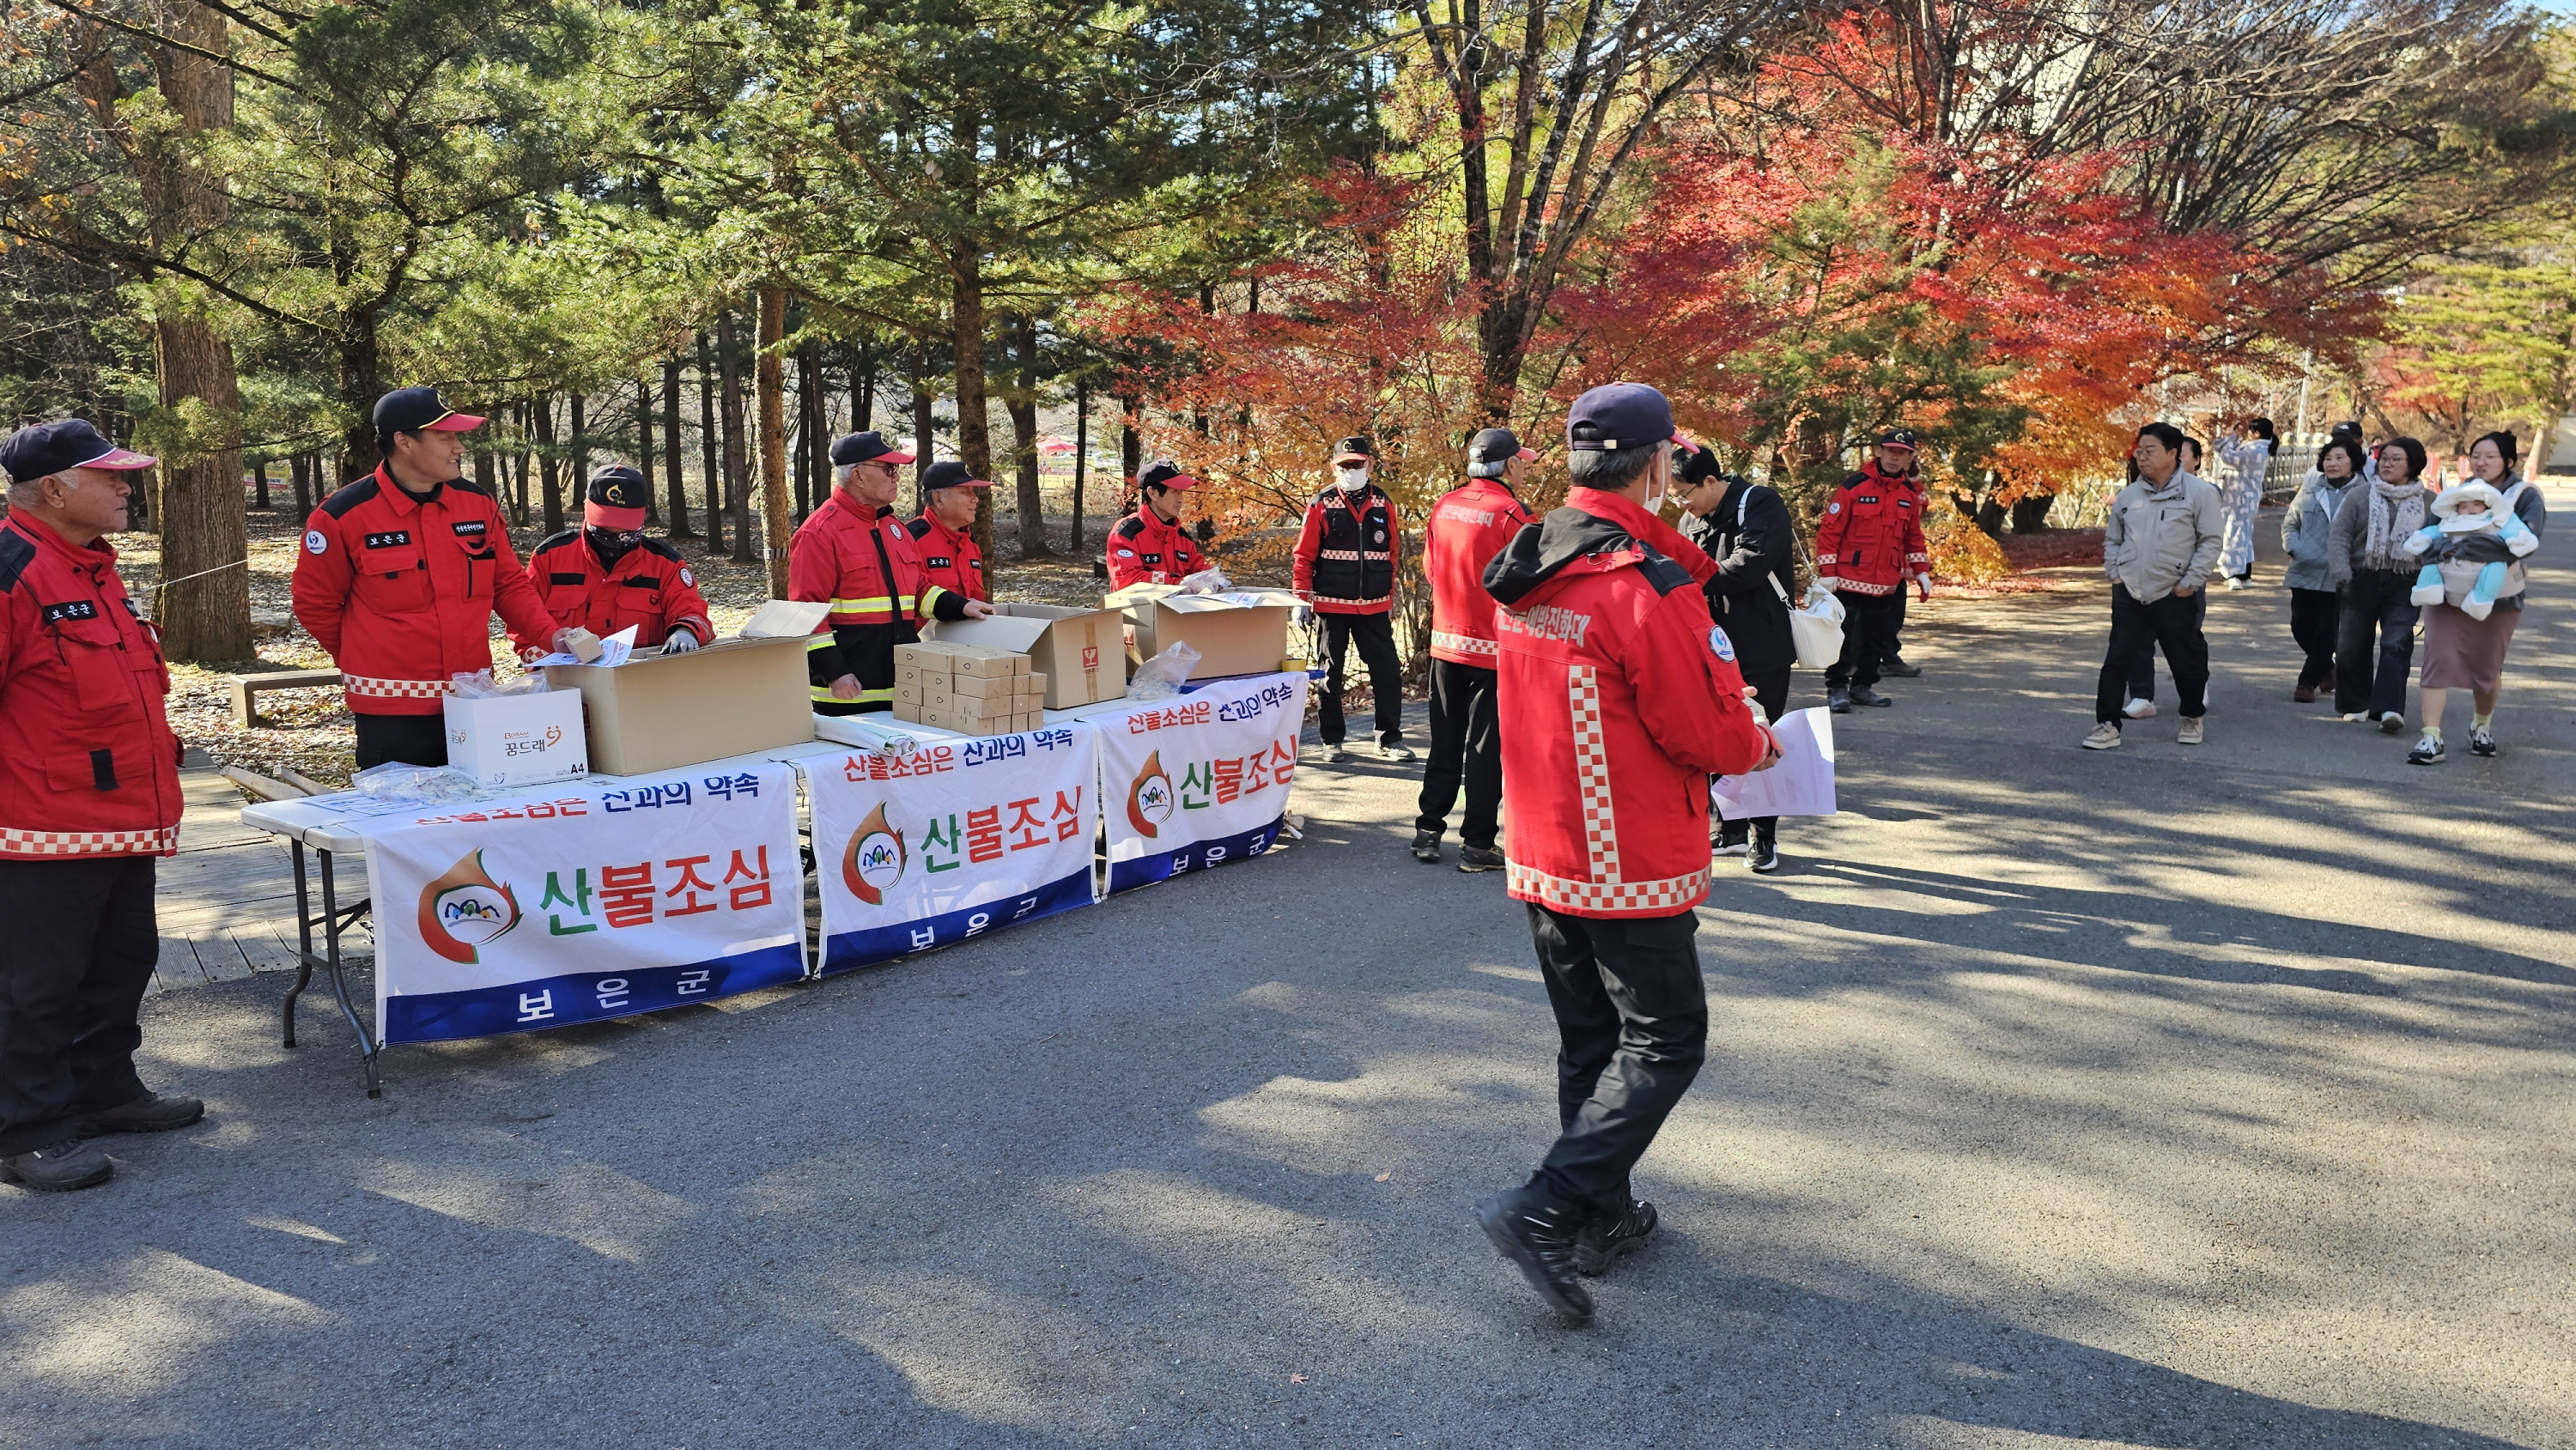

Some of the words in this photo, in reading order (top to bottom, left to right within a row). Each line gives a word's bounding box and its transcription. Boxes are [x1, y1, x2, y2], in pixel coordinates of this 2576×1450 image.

[1127, 700, 1211, 735] 산불조심은
[1261, 682, 1293, 708] 약속
[505, 738, 546, 756] 꿈드래
[570, 762, 585, 774] A4
[843, 745, 954, 782] 산불조심은
[963, 735, 1026, 767] 산과의
[1033, 728, 1073, 751] 약속
[1180, 733, 1297, 810] 산불조심
[601, 781, 692, 813] 산과의
[703, 772, 760, 802] 약속
[920, 785, 1082, 874] 산불조심
[539, 844, 773, 937] 산불조심
